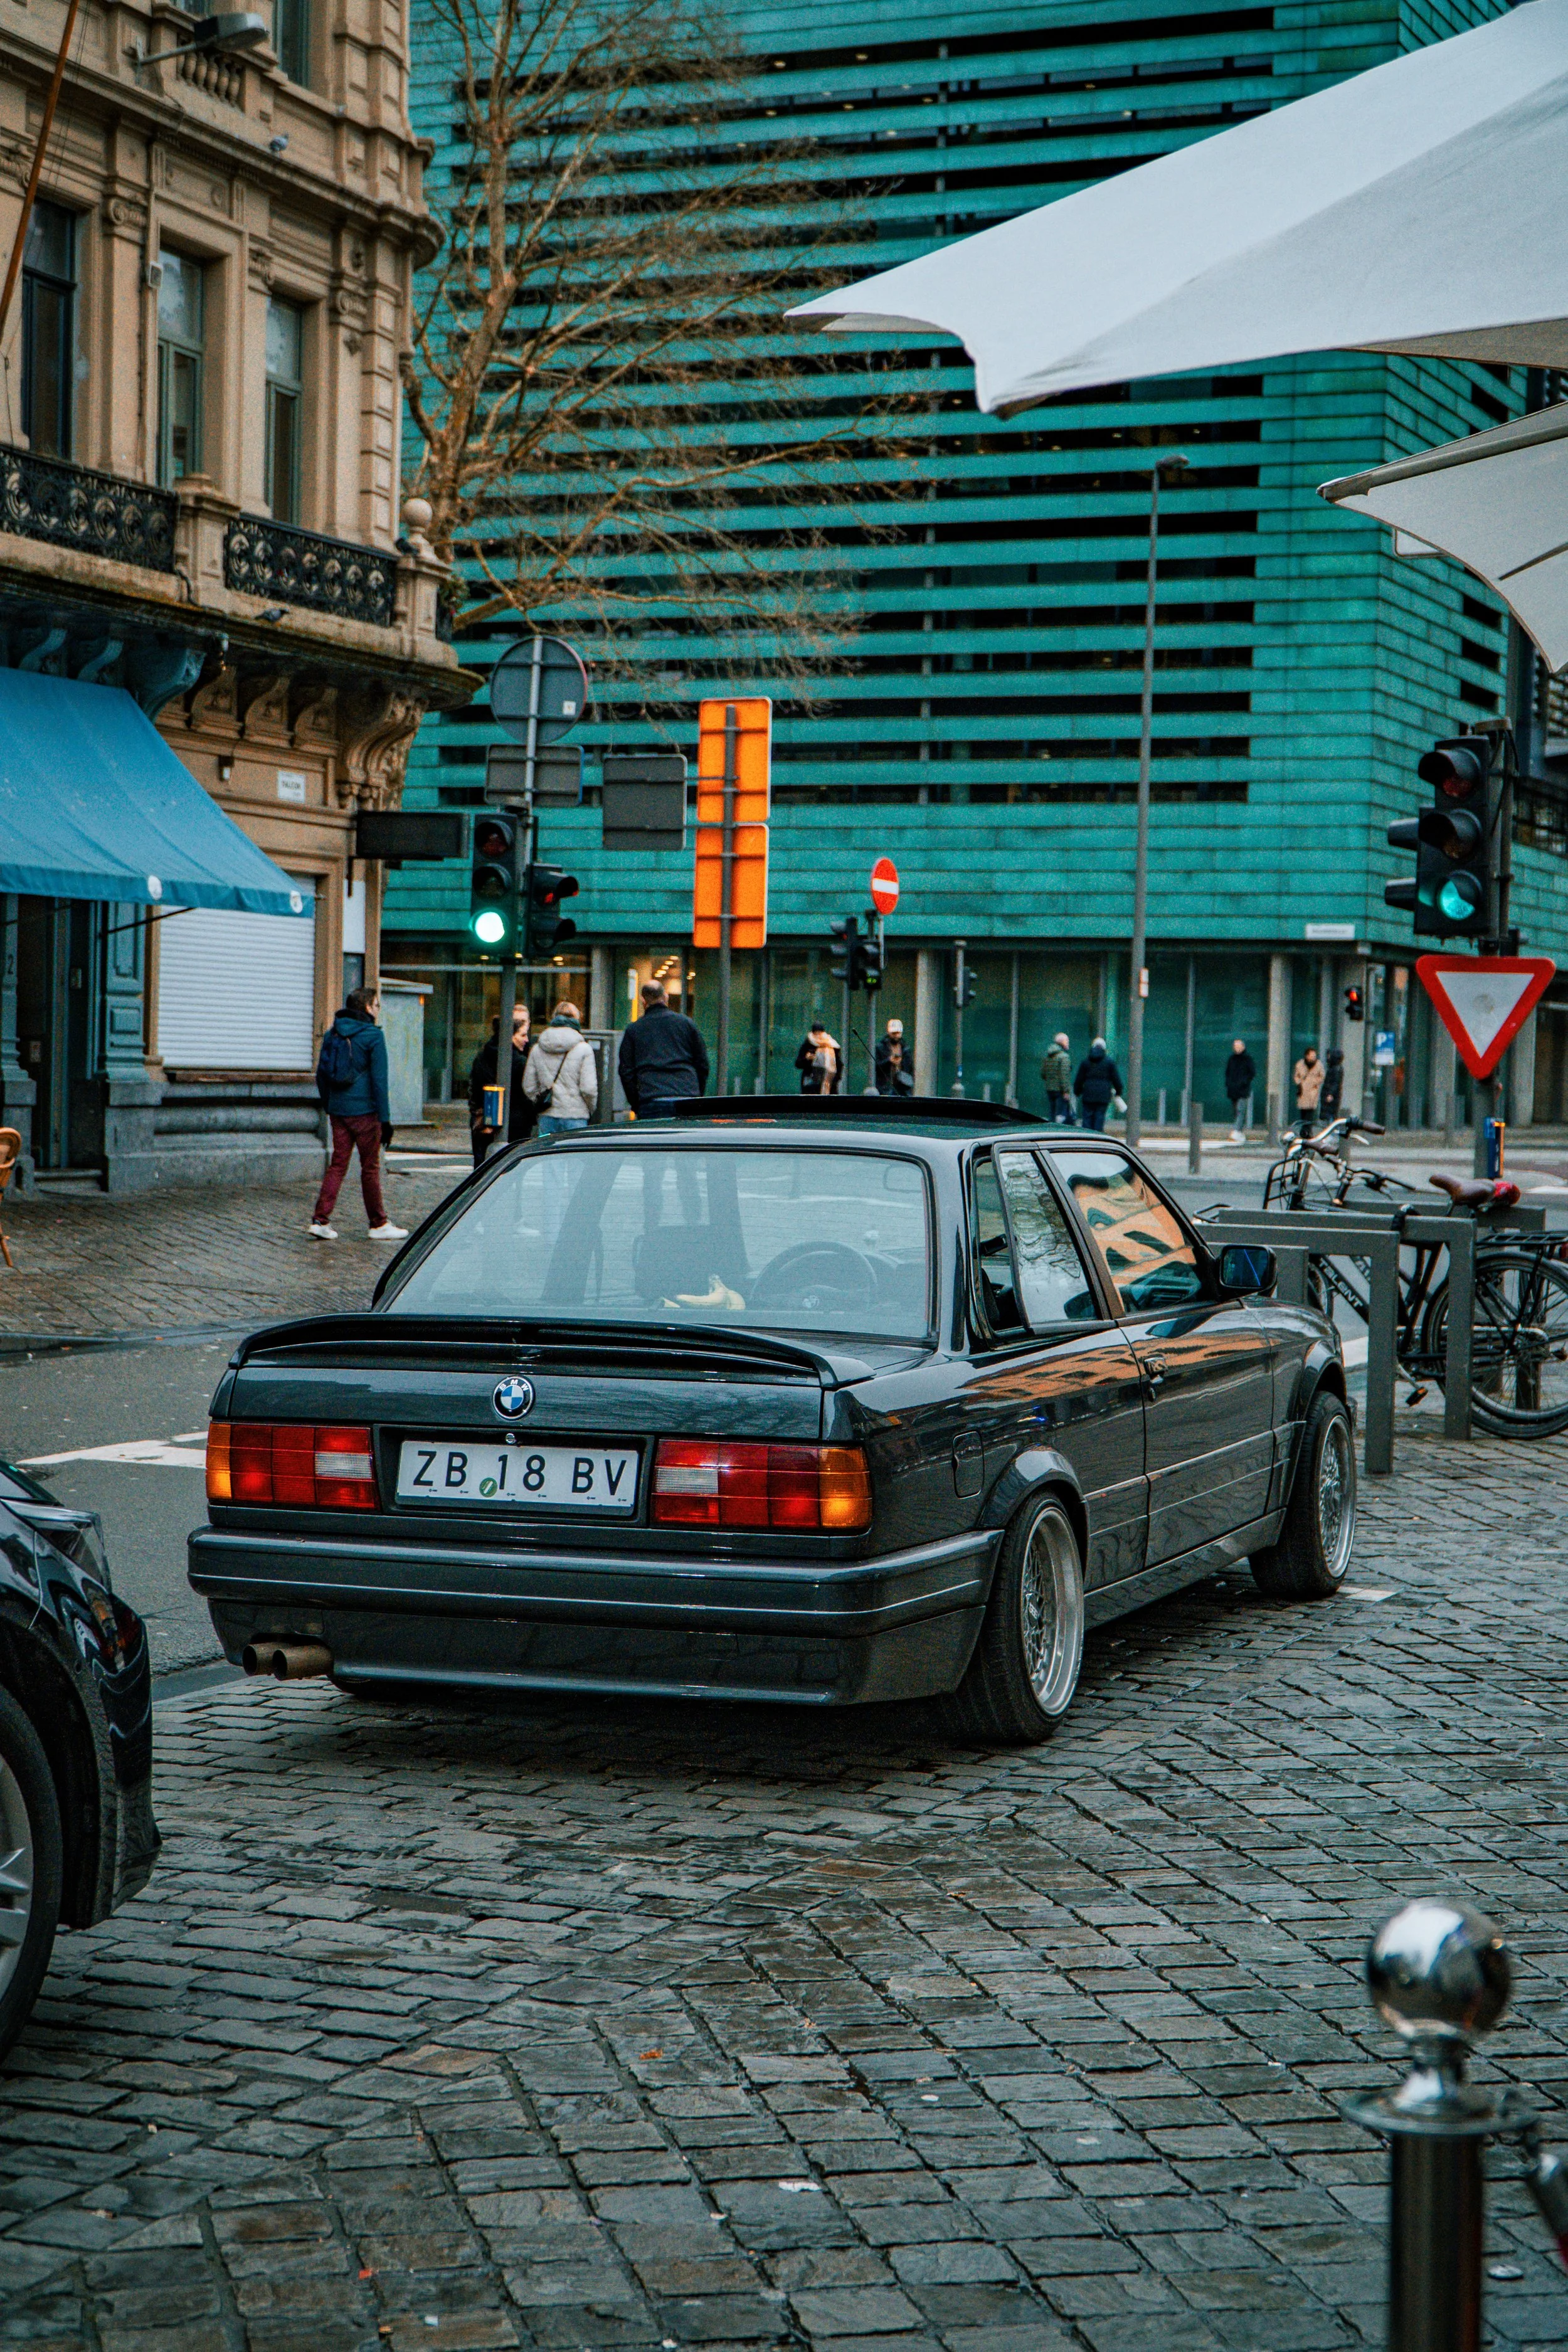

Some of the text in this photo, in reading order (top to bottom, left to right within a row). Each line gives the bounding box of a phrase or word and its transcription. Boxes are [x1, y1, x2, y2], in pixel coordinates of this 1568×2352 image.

[7, 954, 14, 975] 2
[1377, 1032, 1387, 1047] P
[499, 1379, 529, 1391] BMW
[413, 1450, 627, 1496] ZB 18 BV
